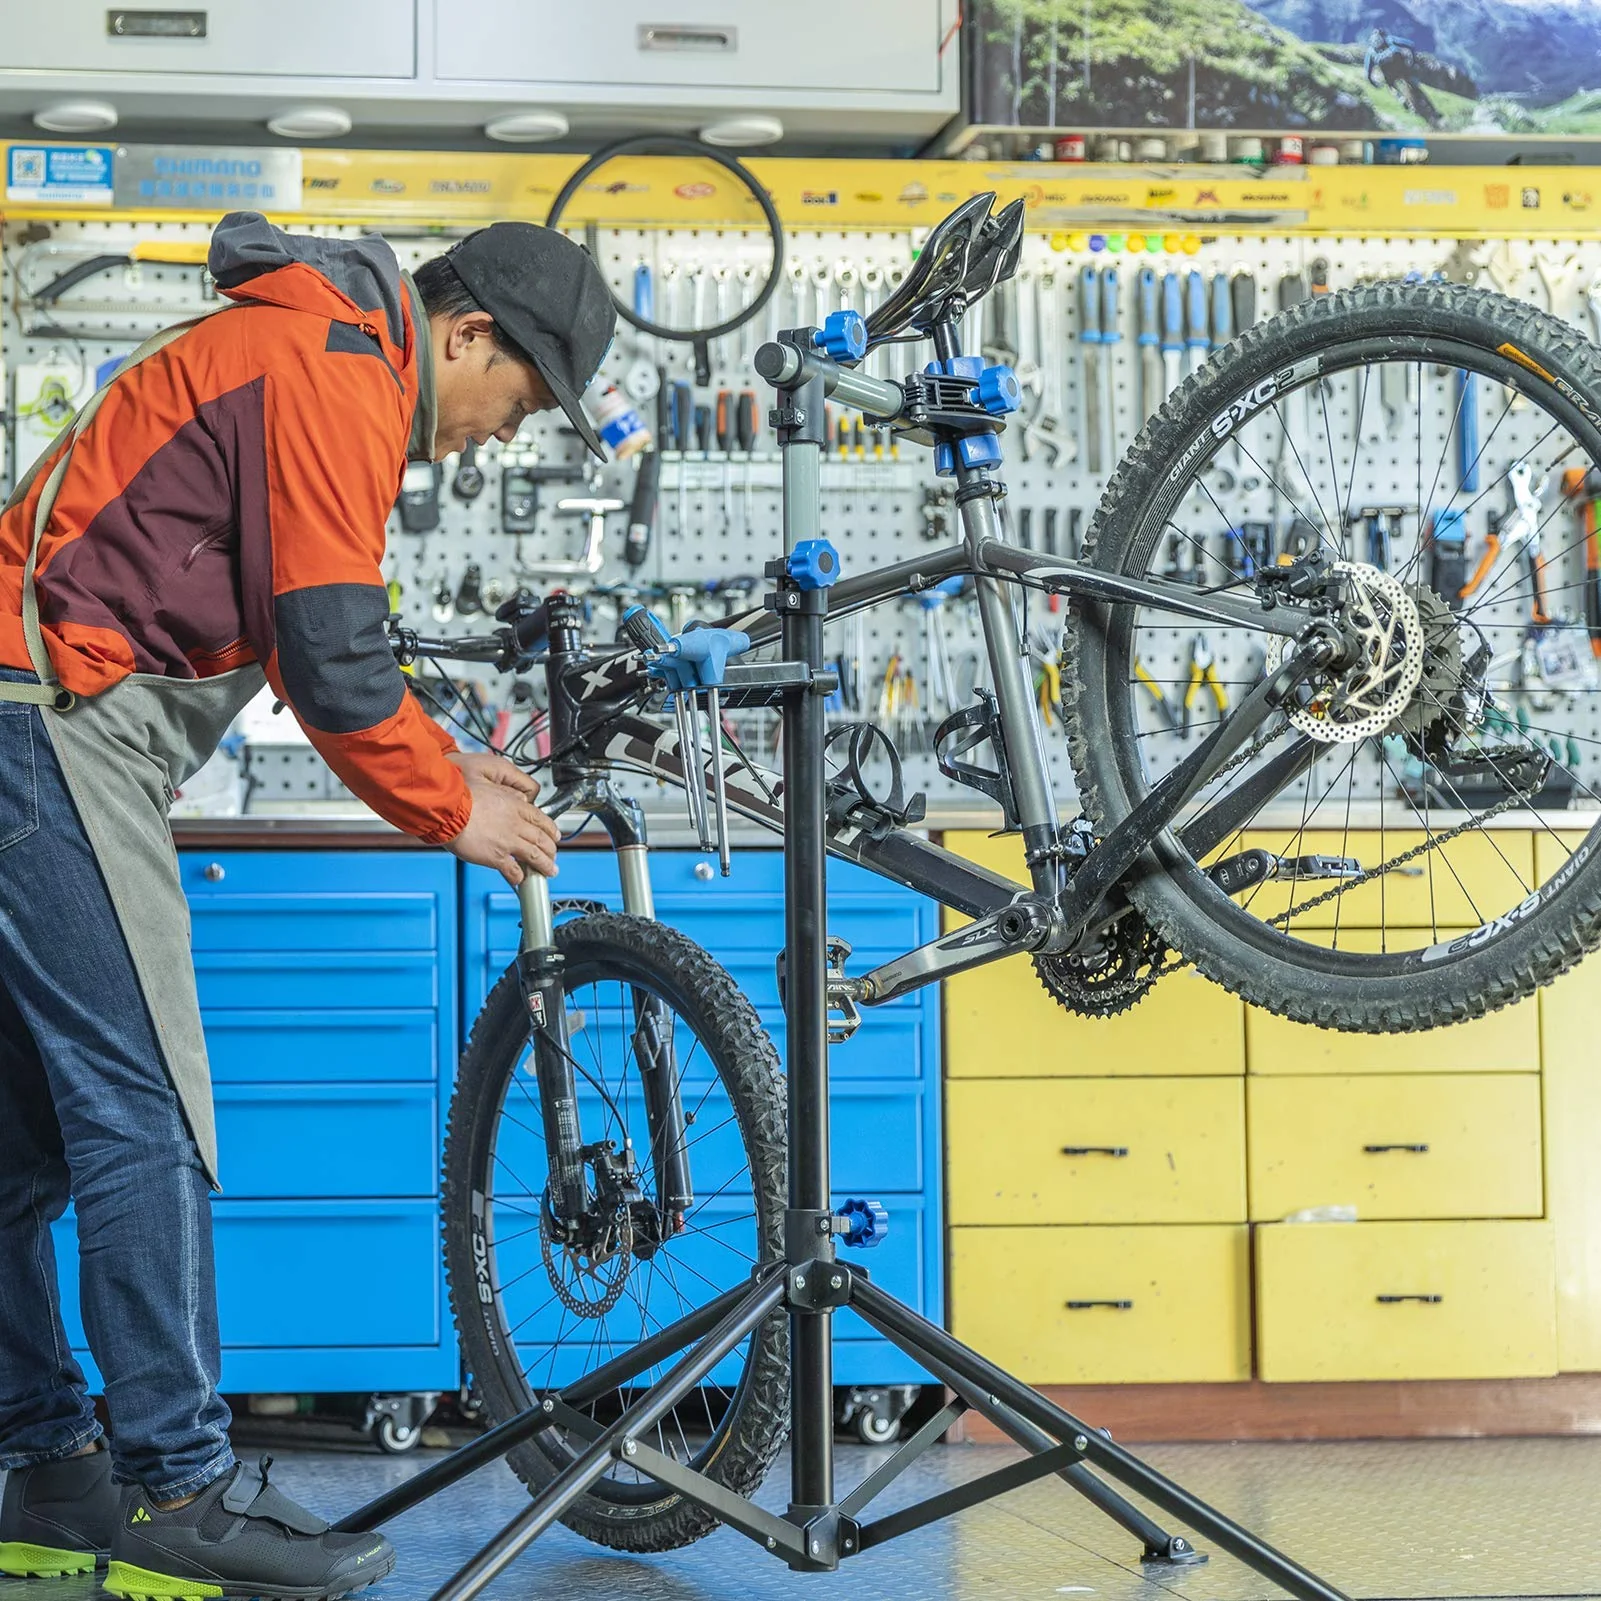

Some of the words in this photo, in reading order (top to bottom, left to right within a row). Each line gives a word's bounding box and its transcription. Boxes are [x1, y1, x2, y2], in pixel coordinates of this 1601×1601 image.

[1170, 427, 1212, 482] GIANT
[1547, 846, 1589, 898] GIANT
[961, 924, 998, 946] SLX
[484, 1311, 500, 1357] GIANT
